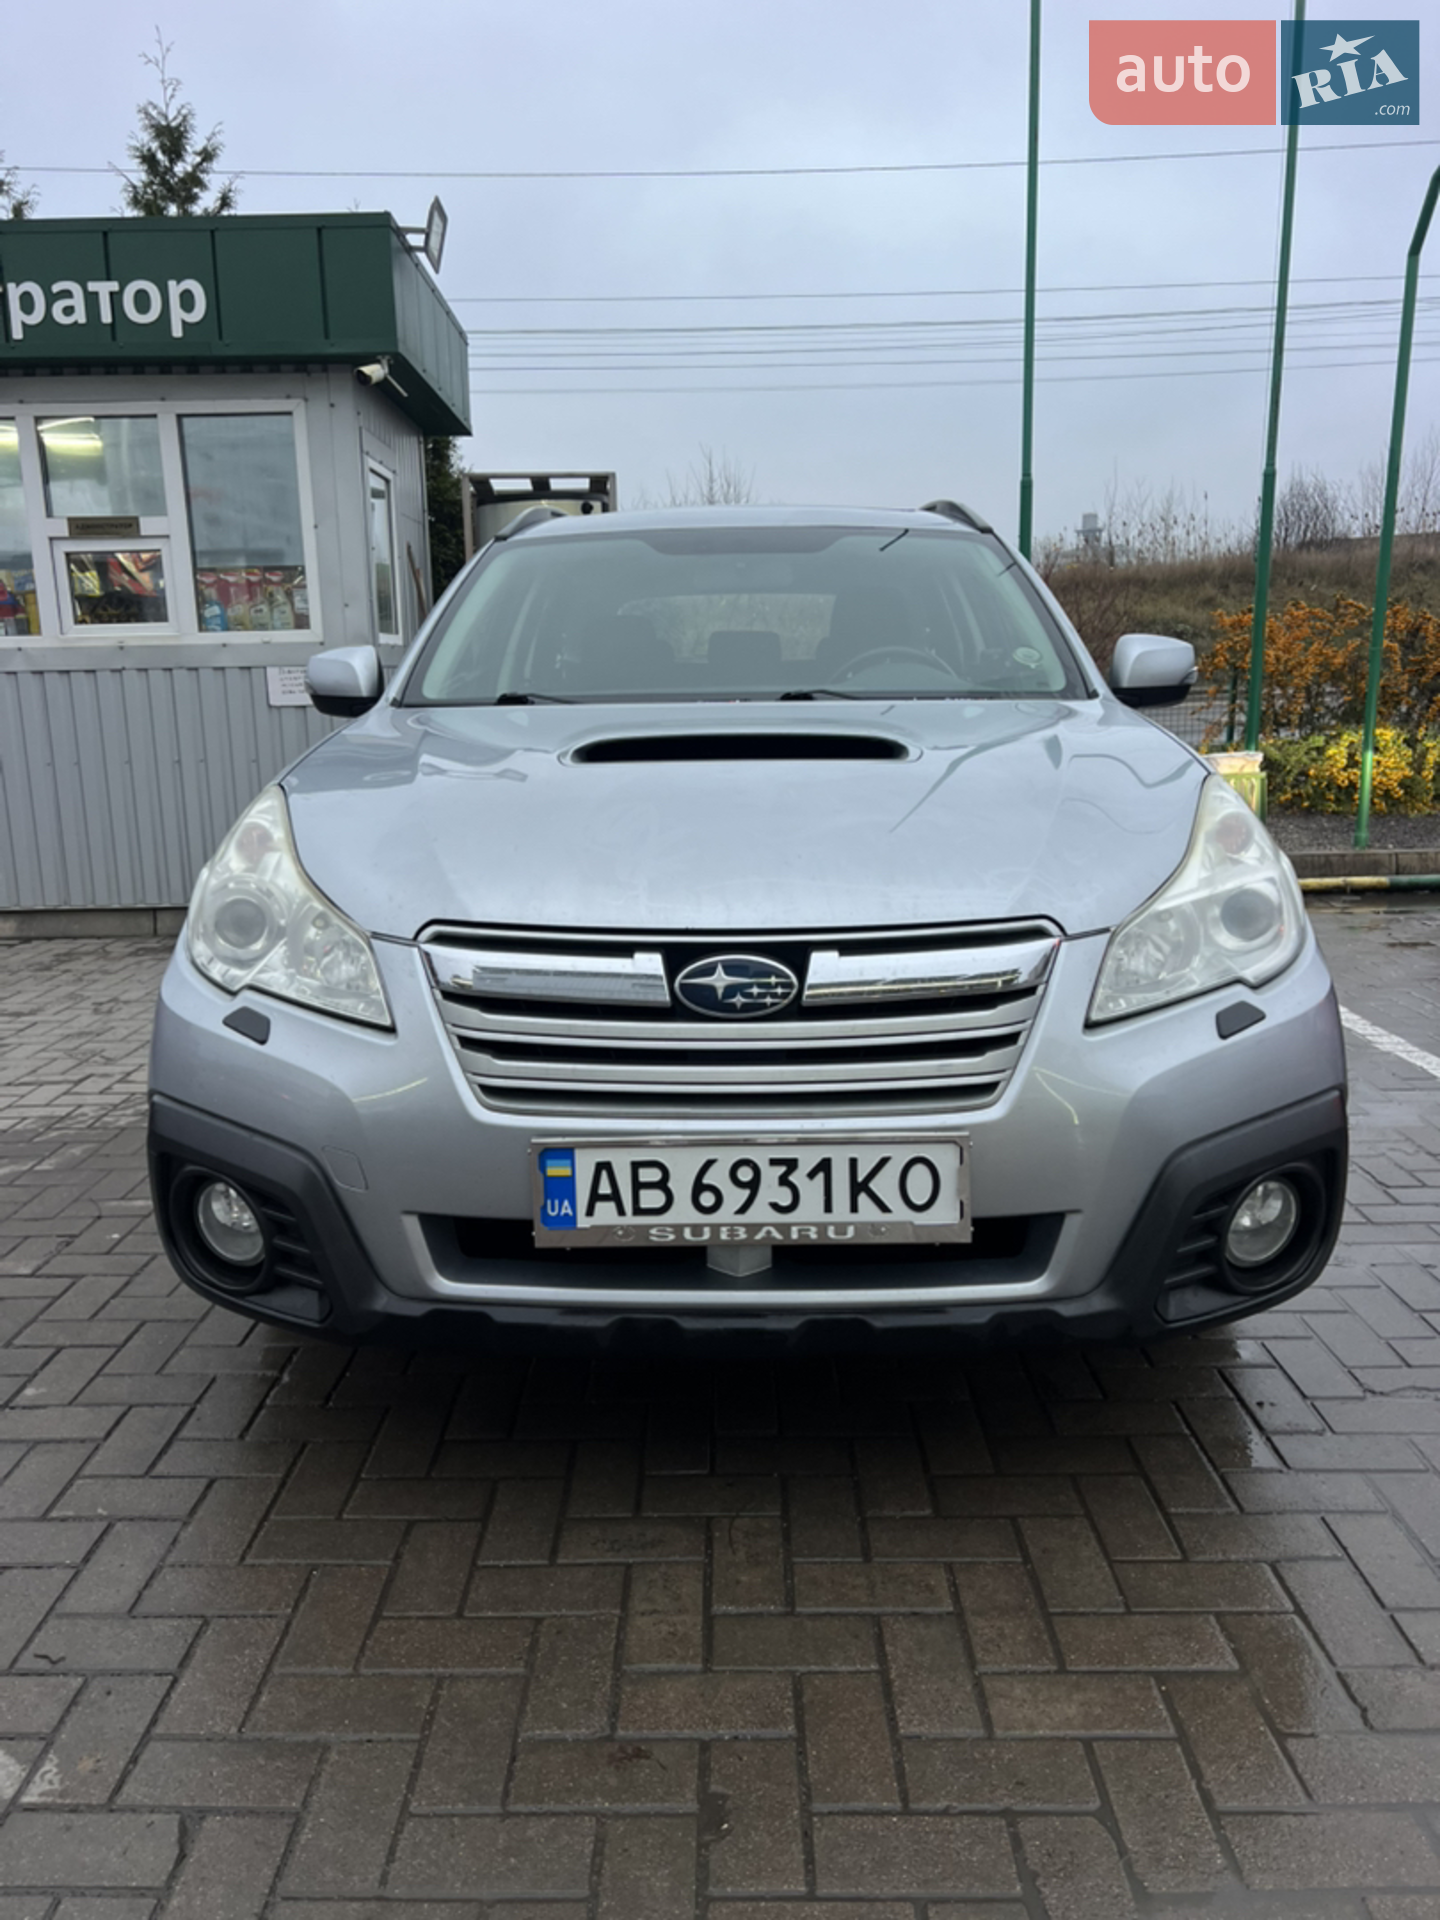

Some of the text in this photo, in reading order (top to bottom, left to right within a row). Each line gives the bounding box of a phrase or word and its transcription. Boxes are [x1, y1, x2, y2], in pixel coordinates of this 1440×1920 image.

[0, 279, 207, 340] ратор
[585, 1156, 941, 1217] AB 6931 KO
[546, 1199, 573, 1217] UA
[648, 1225, 856, 1242] SUBARU
